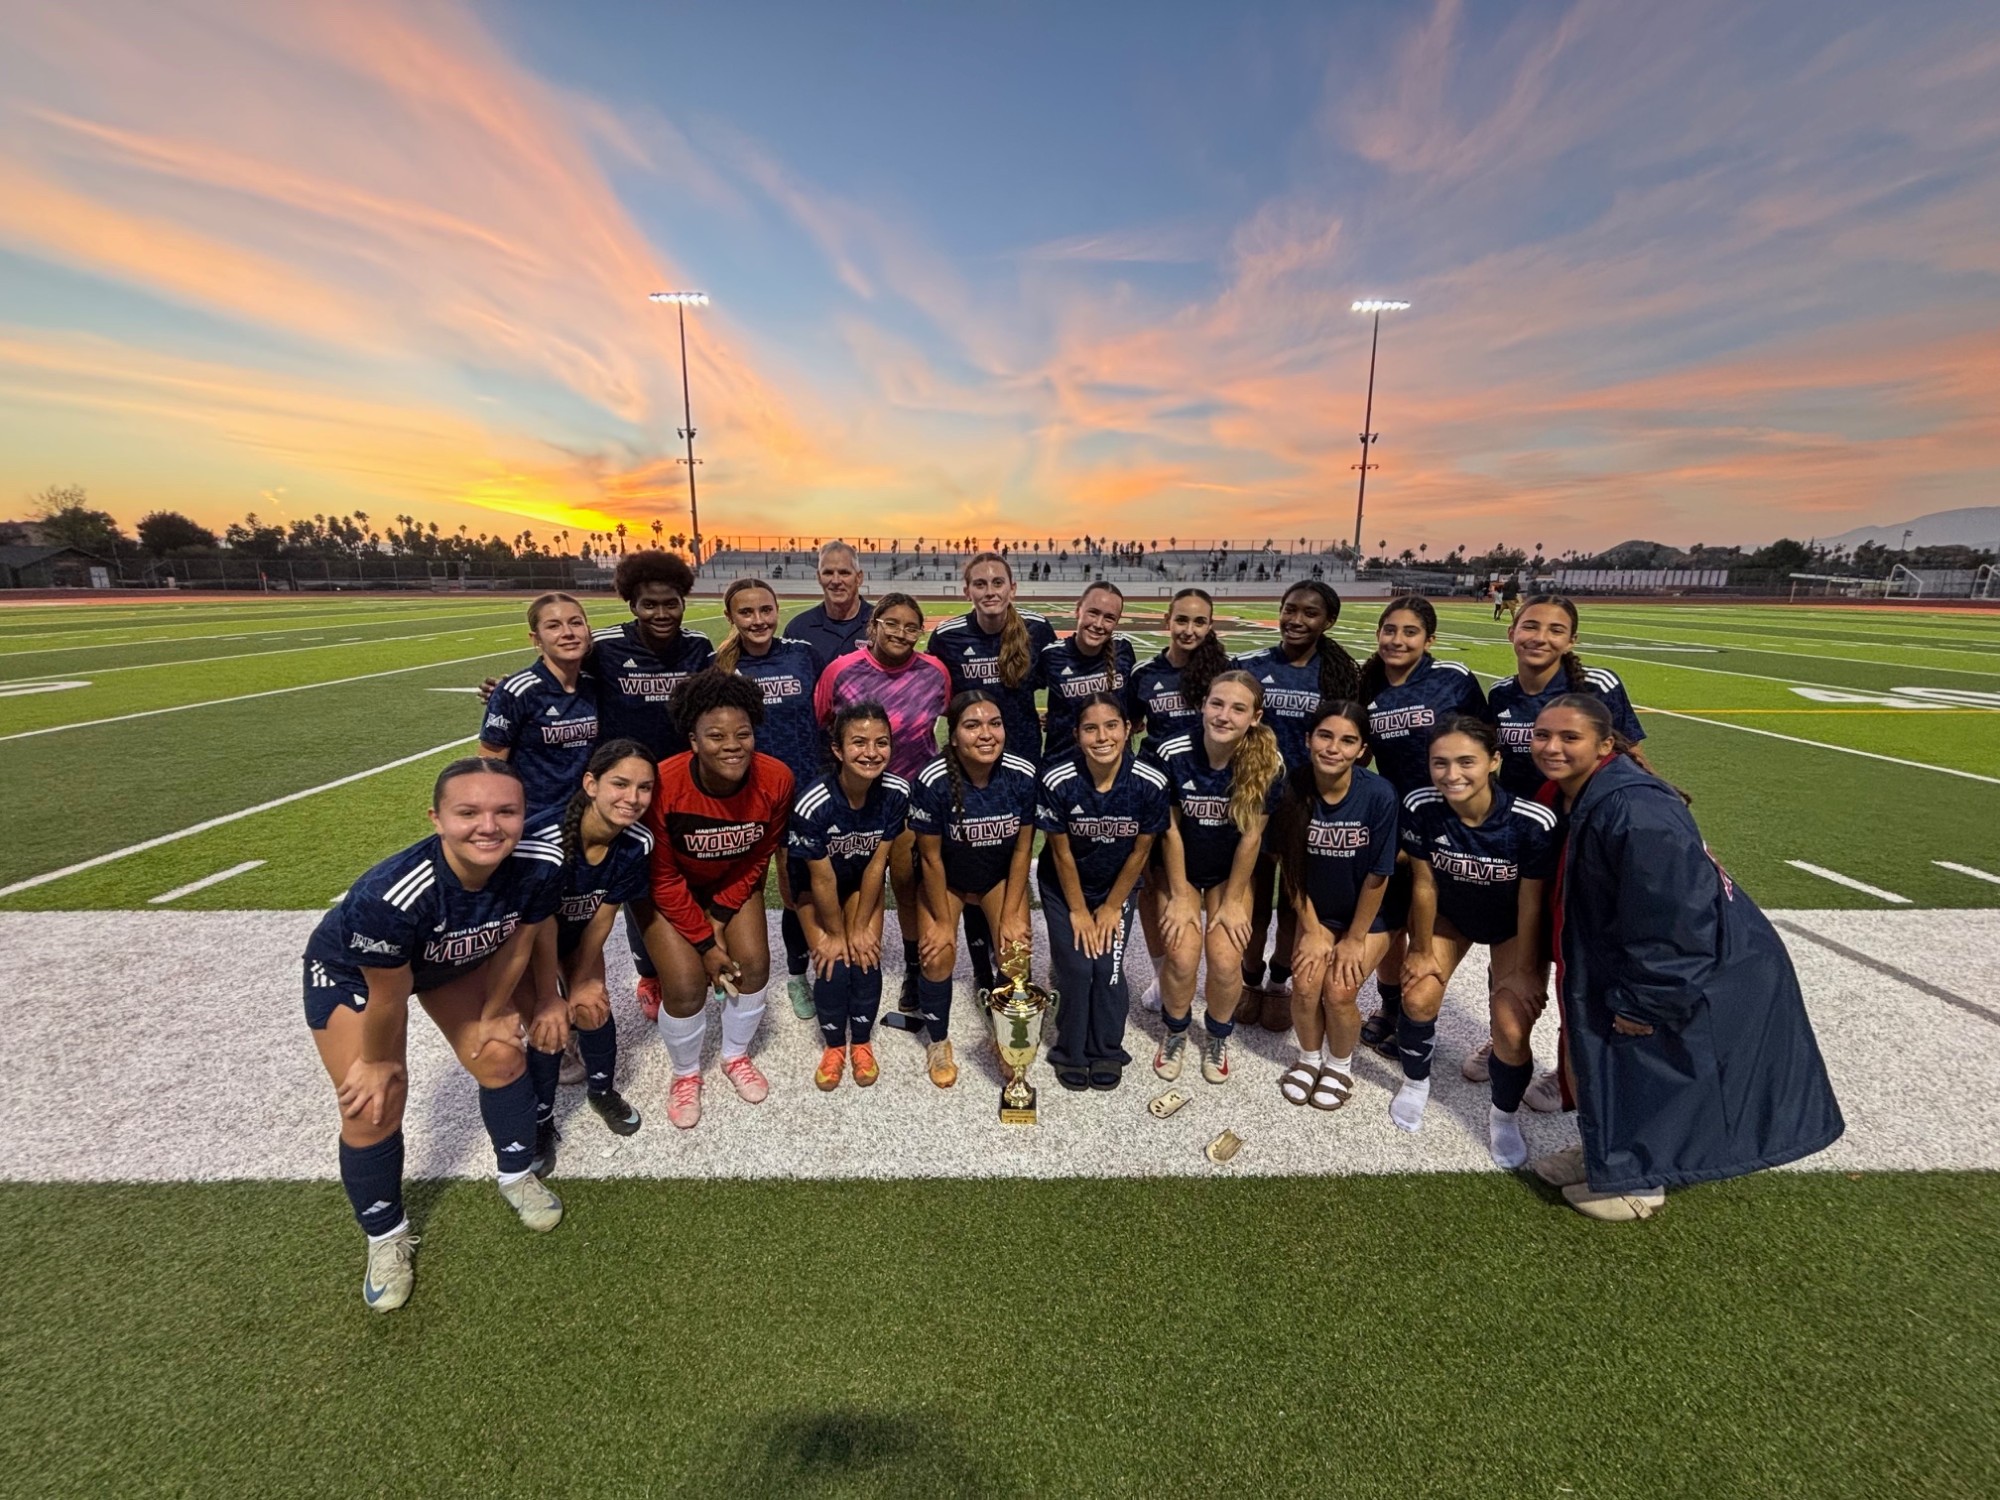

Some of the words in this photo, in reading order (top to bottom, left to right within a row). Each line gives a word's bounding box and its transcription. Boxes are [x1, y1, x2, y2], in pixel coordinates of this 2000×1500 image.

[961, 661, 1000, 679] WOL
[617, 677, 691, 695] WOLV
[758, 675, 779, 683] LUTHER
[1060, 673, 1124, 698] WOLVS
[758, 680, 802, 698] LVES
[644, 694, 670, 702] SOCCE
[762, 697, 783, 705] CCER
[1149, 695, 1188, 713] WOL
[1262, 692, 1321, 714] WOLVE
[1276, 709, 1305, 718] SOCCER
[1388, 707, 1410, 716] LUTHER
[541, 720, 599, 744] WOLVE
[1380, 729, 1410, 740] SOCCER
[1496, 727, 1535, 745] WOL
[1512, 745, 1532, 754] SOC
[979, 815, 1001, 823] LUTHER
[1001, 812, 1014, 820] KING
[1179, 799, 1231, 819] WOLV
[694, 827, 718, 835] MARTIN
[718, 824, 741, 833] LUTHER
[741, 821, 756, 830] KING
[1068, 820, 1140, 837] WOLVES
[683, 824, 764, 853] WOLVES
[971, 838, 1003, 848] SOCCER
[1307, 825, 1370, 849] OLVES
[696, 850, 720, 859] GIRLS
[721, 844, 751, 857] SOCCER
[826, 835, 883, 858] WOLVE
[1320, 848, 1356, 858] SOCCER
[1437, 847, 1464, 860] MARTIN
[1463, 852, 1492, 864] LUTHER
[1492, 857, 1512, 865] KING
[1430, 851, 1519, 882] WOLVES
[567, 913, 593, 922] SOCC
